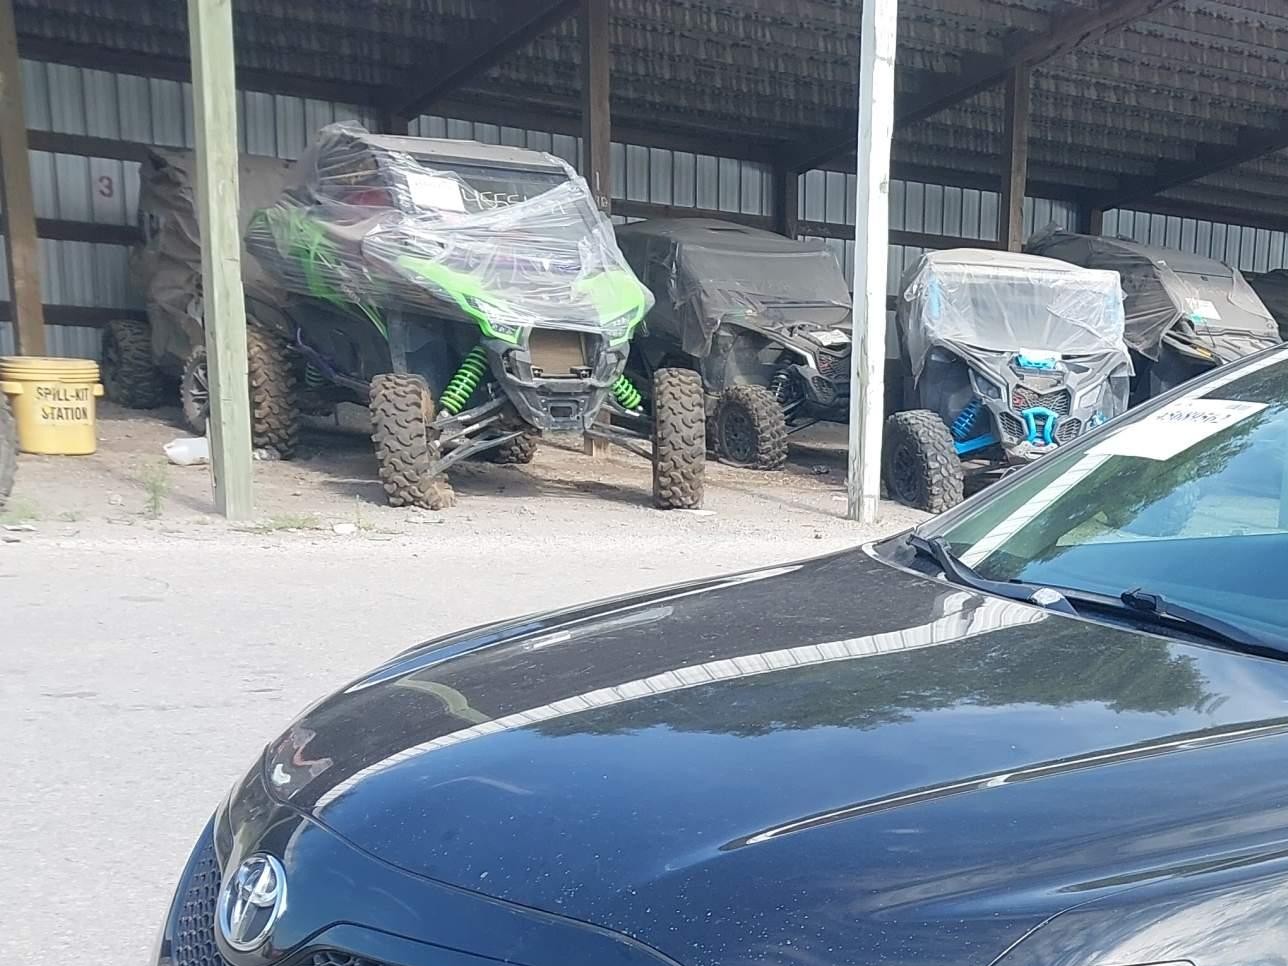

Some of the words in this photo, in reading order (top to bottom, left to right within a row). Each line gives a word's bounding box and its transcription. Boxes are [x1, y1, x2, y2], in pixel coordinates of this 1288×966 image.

[98, 175, 113, 198] 3
[36, 386, 89, 401] SPILL-KIT
[41, 406, 88, 420] STATION
